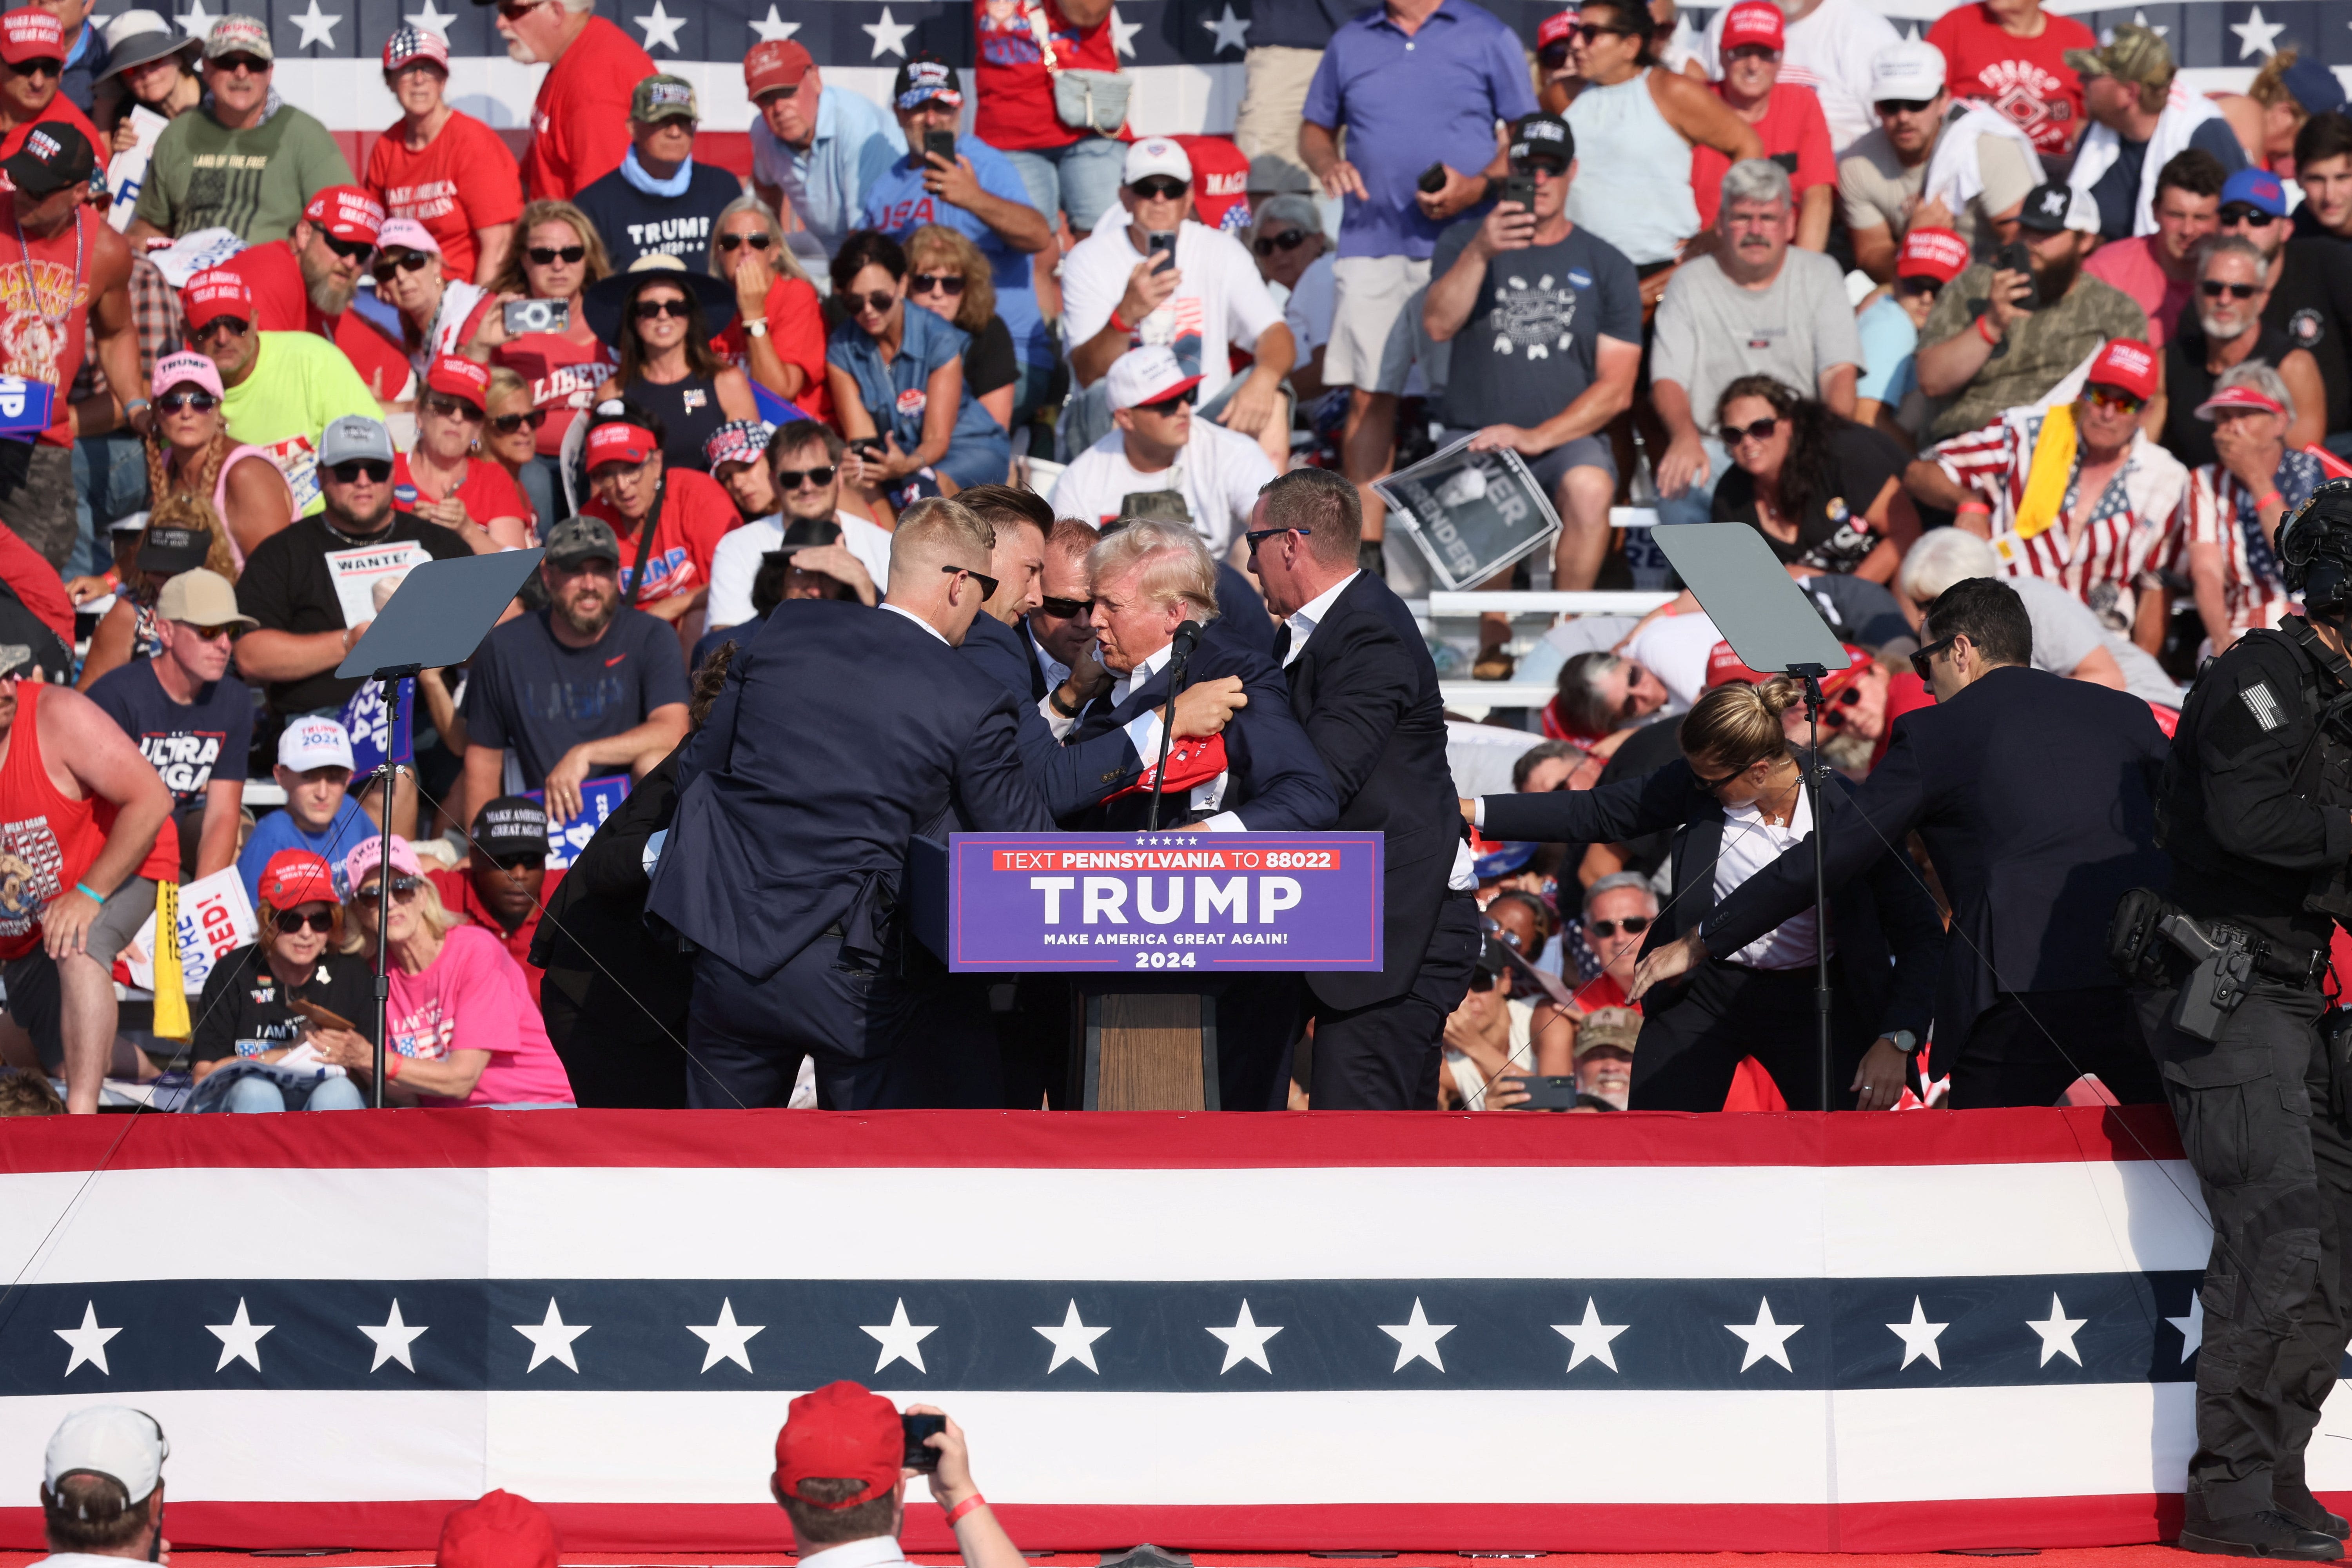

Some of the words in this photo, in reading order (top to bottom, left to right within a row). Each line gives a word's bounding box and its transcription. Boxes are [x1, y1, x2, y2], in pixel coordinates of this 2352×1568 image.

[193, 154, 216, 167] LAND
[216, 155, 228, 168] OF
[229, 155, 246, 169] THE
[246, 156, 267, 169] FREE
[163, 358, 208, 374] TRUMP
[338, 553, 409, 571] WANTE
[302, 726, 338, 736] TRUMP
[303, 735, 339, 746] 2024
[140, 736, 220, 765] ULTRA
[486, 809, 512, 824] MAKE
[491, 824, 521, 838] GREAT
[521, 824, 544, 838] AGAIN
[1003, 853, 1055, 868] TEXT
[1063, 853, 1225, 868] PENNSYLVANIA
[1232, 853, 1259, 868] TO
[1266, 852, 1331, 867] 88022
[1031, 877, 1301, 924] TRUMP
[196, 893, 238, 962] RED!
[1044, 935, 1089, 945] MAKE
[1094, 934, 1167, 944] AMERICA
[1173, 933, 1225, 944] GREAT
[1231, 933, 1287, 944] AGAIN!
[1136, 952, 1196, 968] 2024
[263, 1024, 287, 1040] AM
